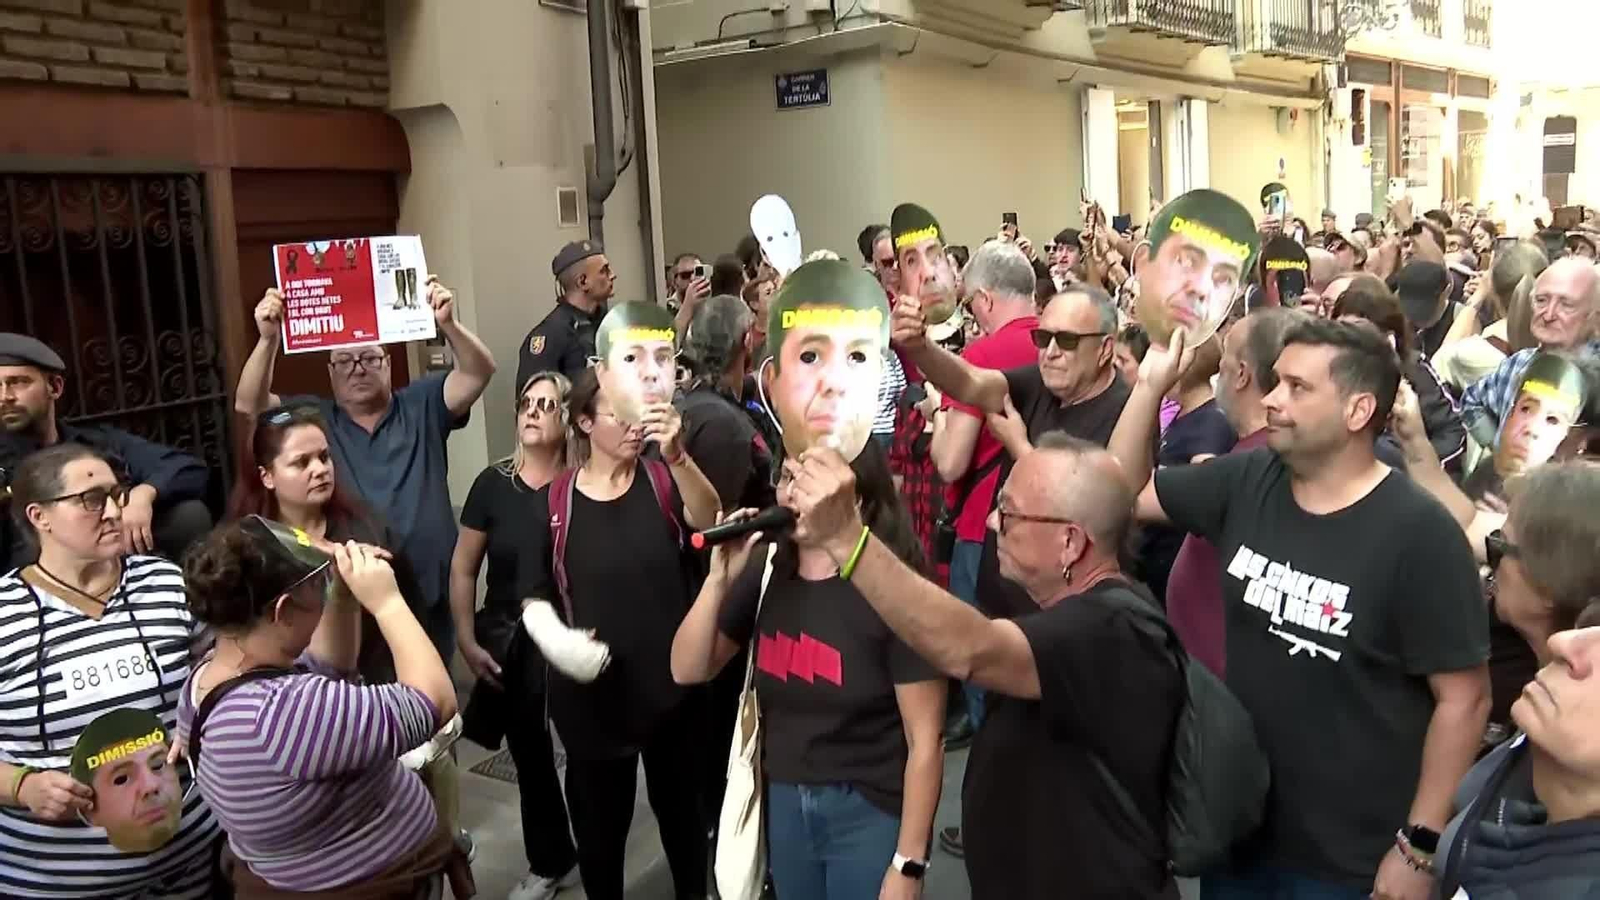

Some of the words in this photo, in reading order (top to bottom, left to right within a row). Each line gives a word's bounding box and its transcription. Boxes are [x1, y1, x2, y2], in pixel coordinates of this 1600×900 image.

[792, 85, 801, 93] DE
[801, 83, 810, 92] LA
[285, 280, 291, 289] A
[286, 290, 292, 299] A
[292, 289, 310, 298] CASA
[287, 299, 299, 308] LES
[289, 314, 344, 336] DIMITIU
[86, 727, 165, 770] DIMISSIÓ
